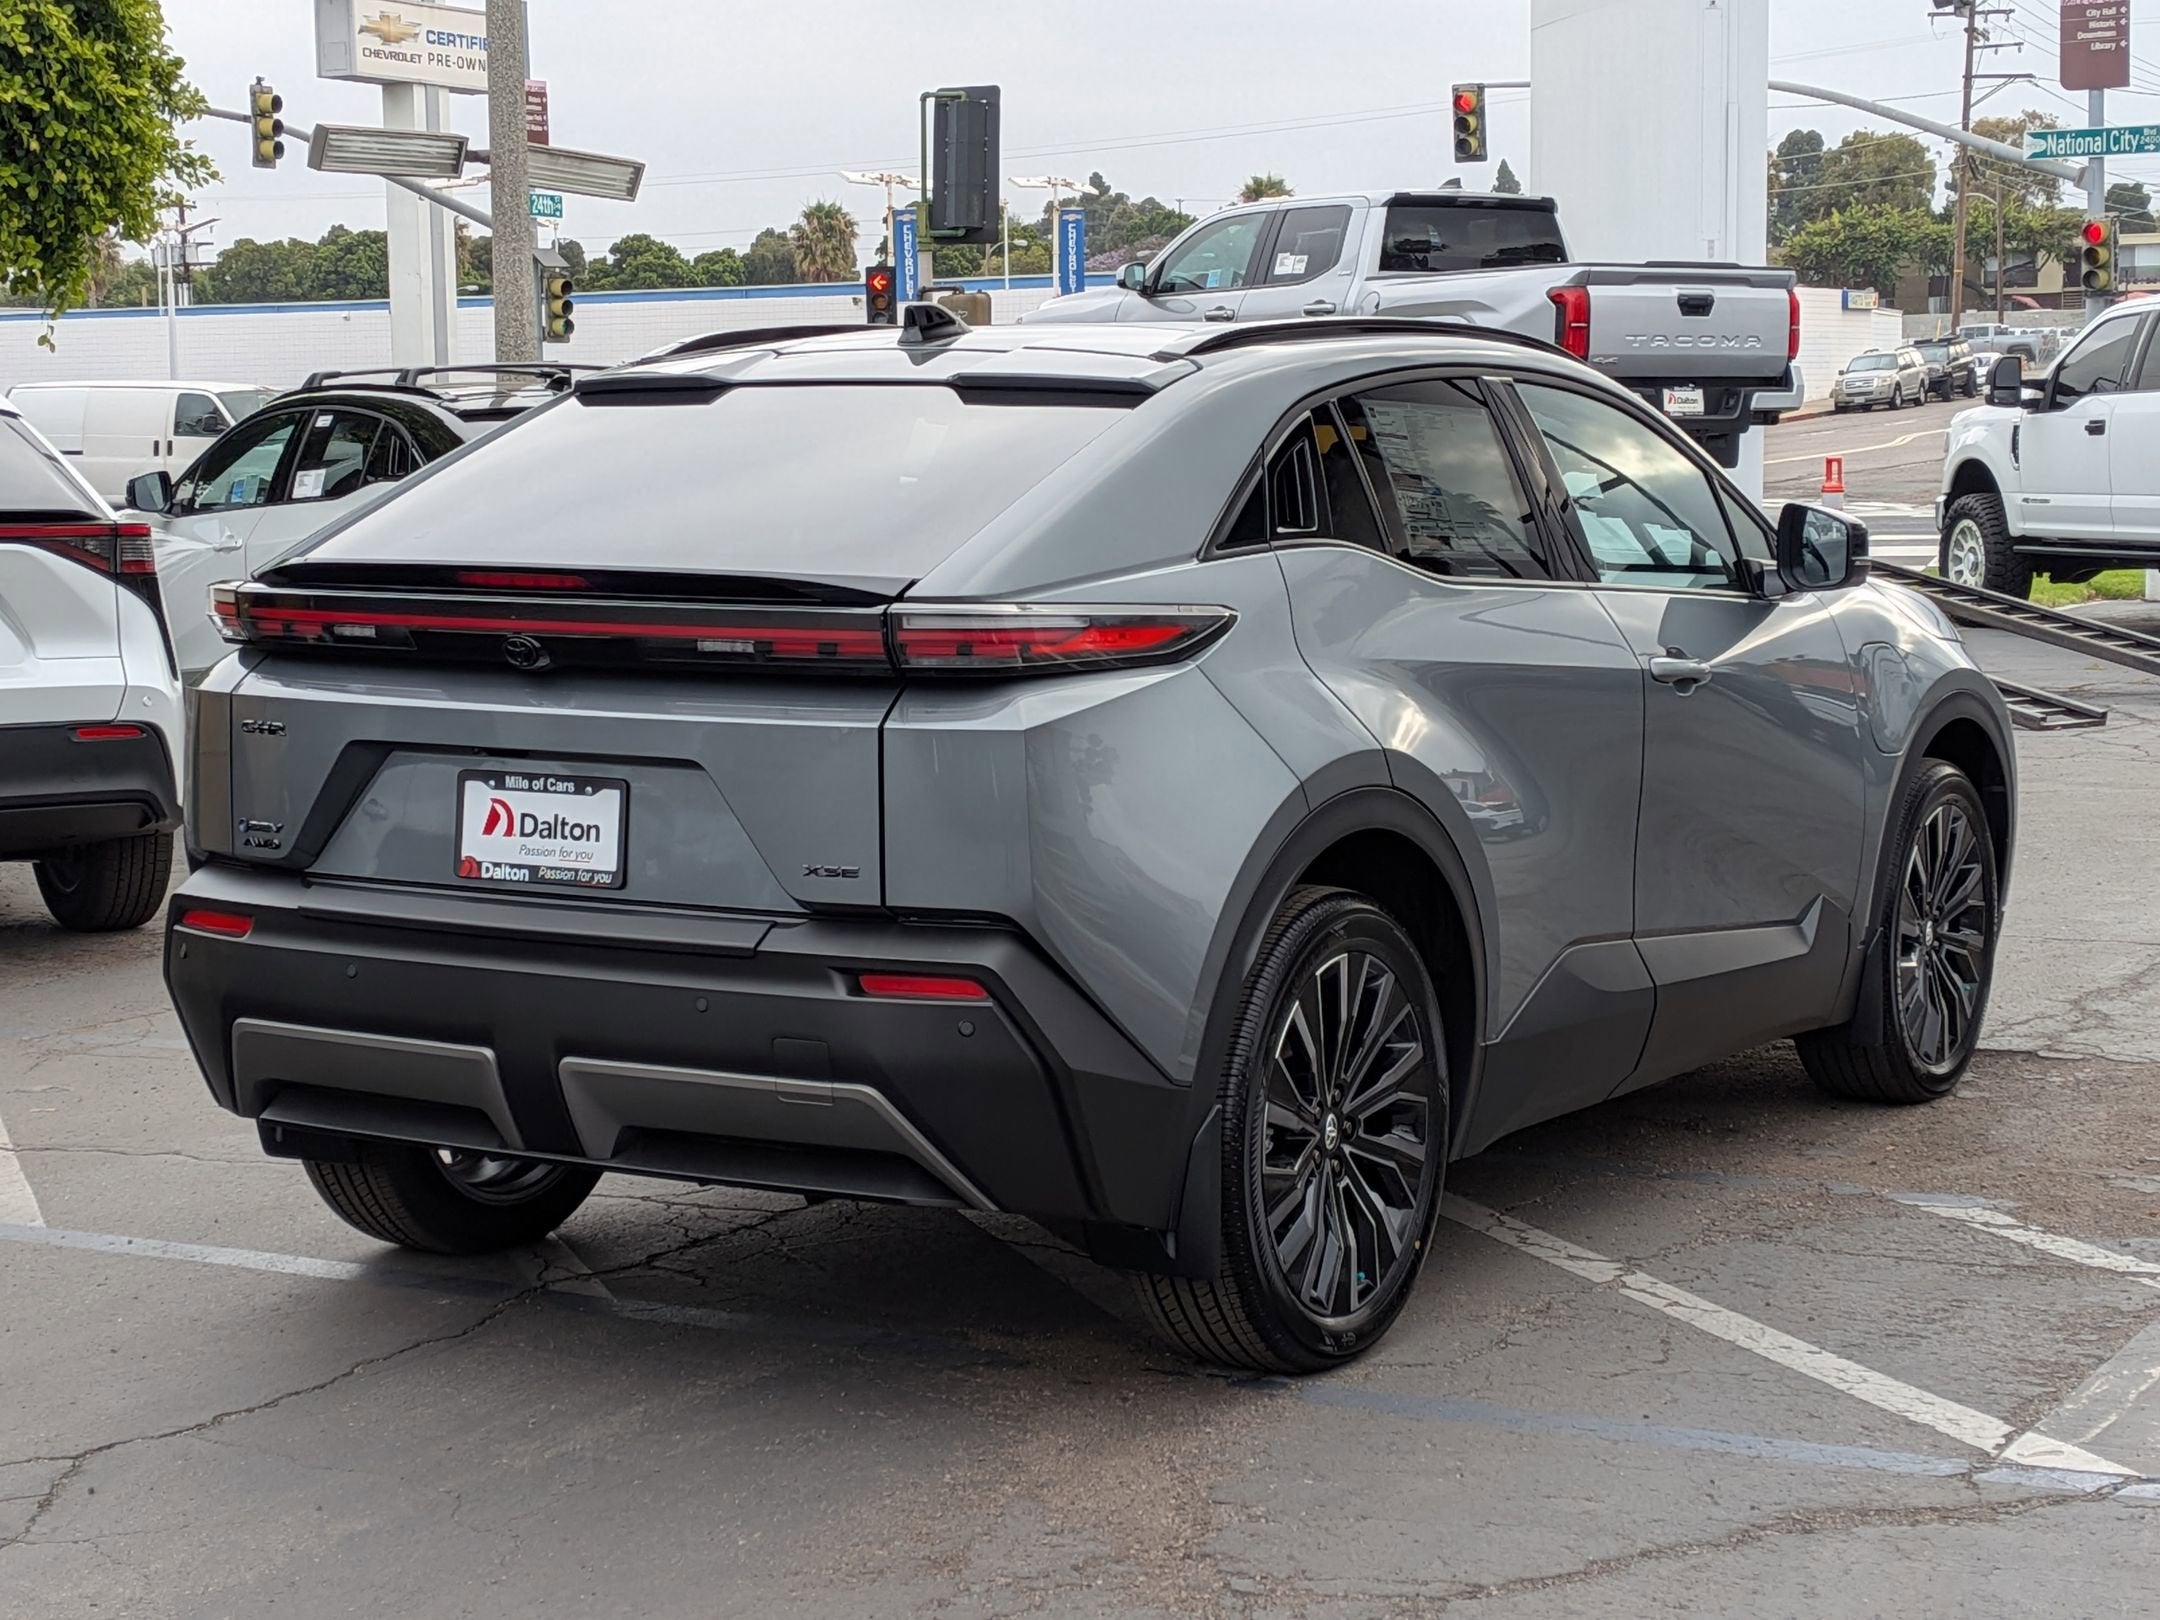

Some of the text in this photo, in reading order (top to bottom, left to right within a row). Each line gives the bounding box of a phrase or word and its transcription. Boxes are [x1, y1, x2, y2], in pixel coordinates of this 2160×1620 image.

[426, 29, 489, 51] CERTIFIE
[362, 47, 423, 64] CHEVROLET
[427, 52, 487, 72] PRE-OWN
[2046, 129, 2140, 156] National City
[531, 194, 554, 215] 24th
[1625, 334, 1762, 348] TACOMA
[505, 775, 575, 793] Mile of Cars
[519, 812, 600, 843] Dalton
[519, 844, 594, 861] Passion for you
[481, 862, 613, 885] Dalton Passion for you
